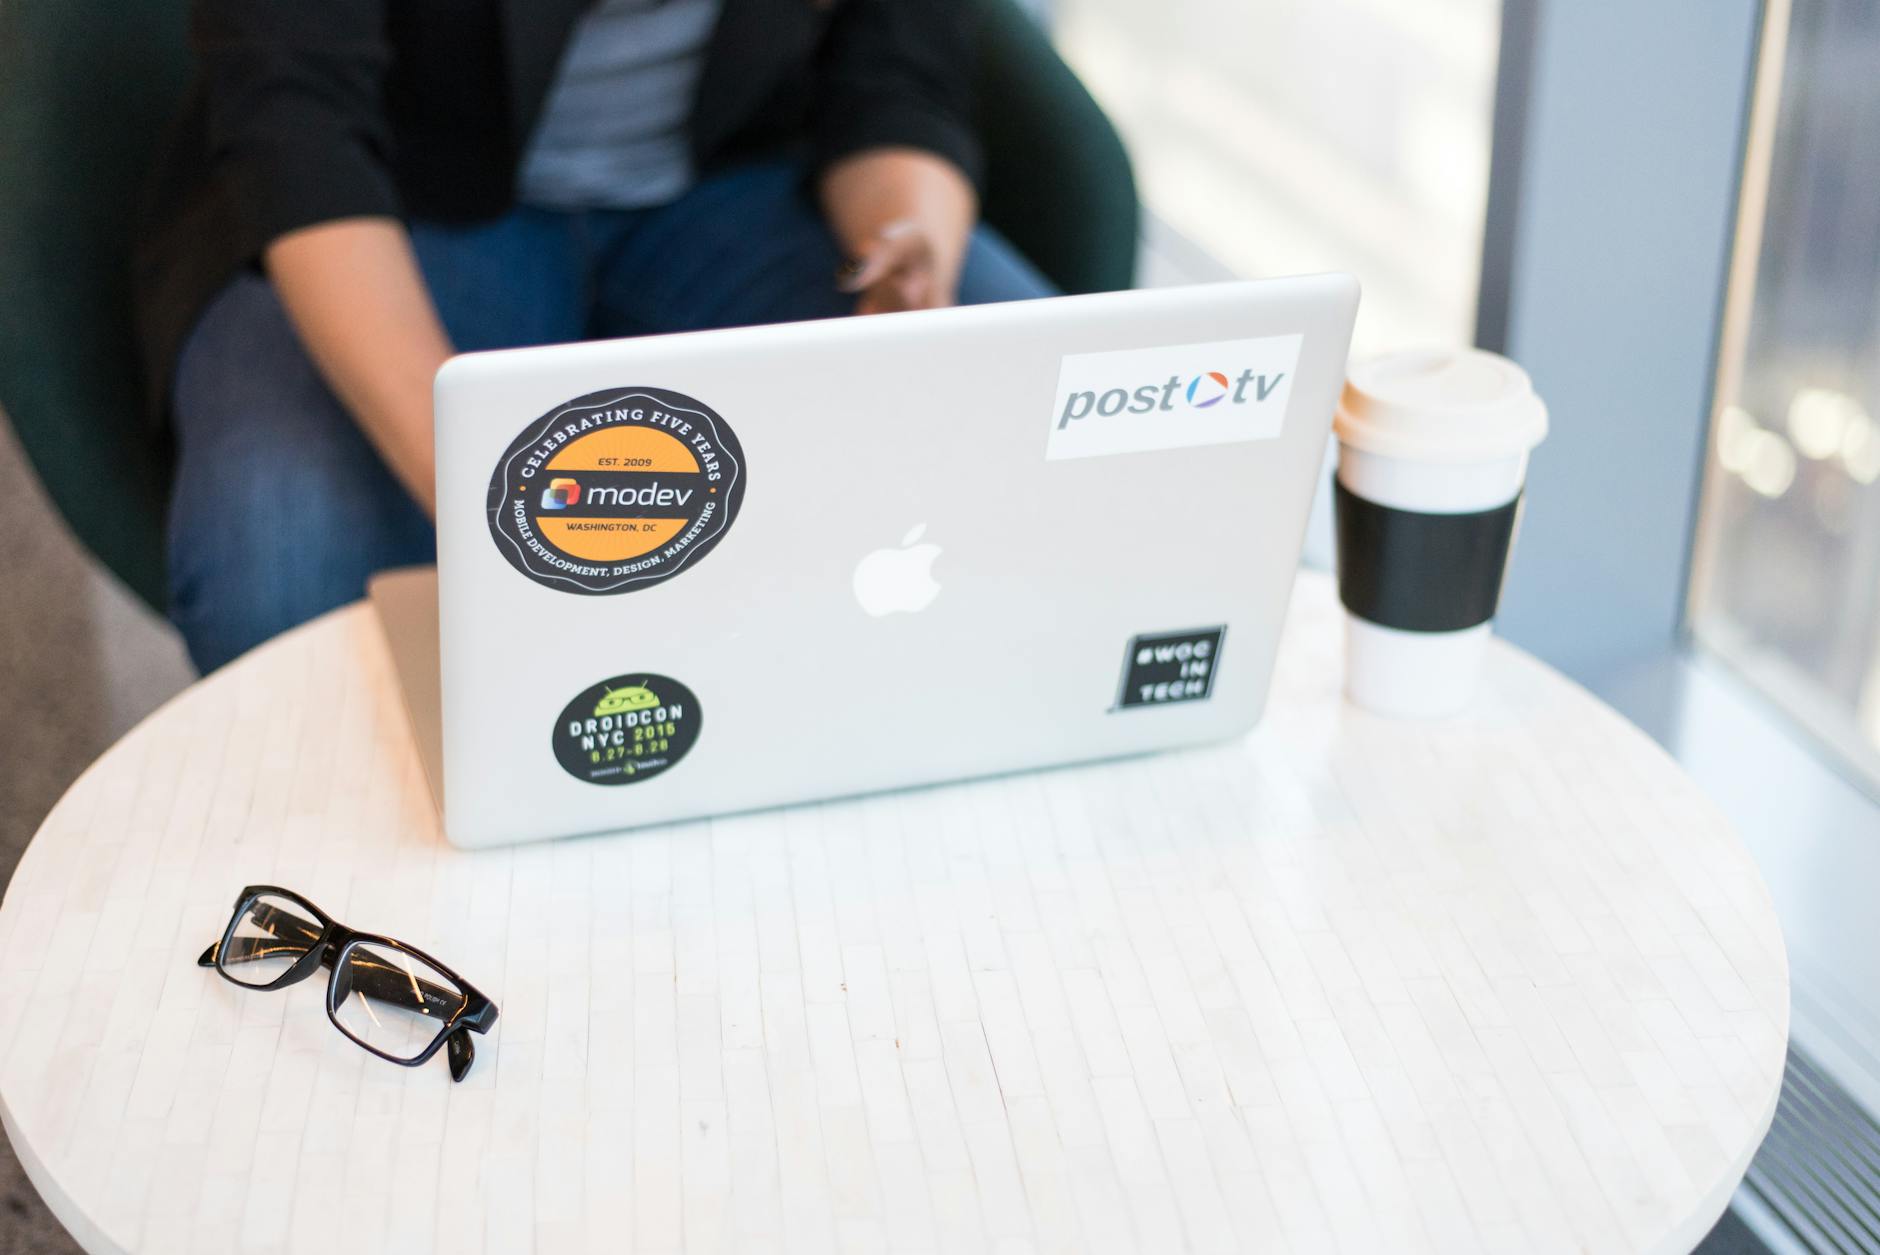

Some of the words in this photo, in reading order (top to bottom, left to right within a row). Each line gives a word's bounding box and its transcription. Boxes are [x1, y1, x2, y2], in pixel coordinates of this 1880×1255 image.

[1057, 375, 1182, 430] post
[1232, 368, 1286, 404] tv
[521, 409, 644, 479] CELEBRATING
[650, 411, 693, 436] FIVE
[691, 433, 722, 481] YEARS
[598, 458, 620, 467] EST.
[624, 458, 653, 467] 2009
[587, 482, 693, 506] modev
[514, 499, 533, 540] MOBILE
[527, 537, 611, 578] DEVELOPMENT,
[613, 555, 665, 577] DESIGN,
[665, 501, 716, 559] MARKETING
[643, 523, 657, 532] DC
[569, 704, 683, 737] DROIDCON
[582, 730, 625, 751] NYC
